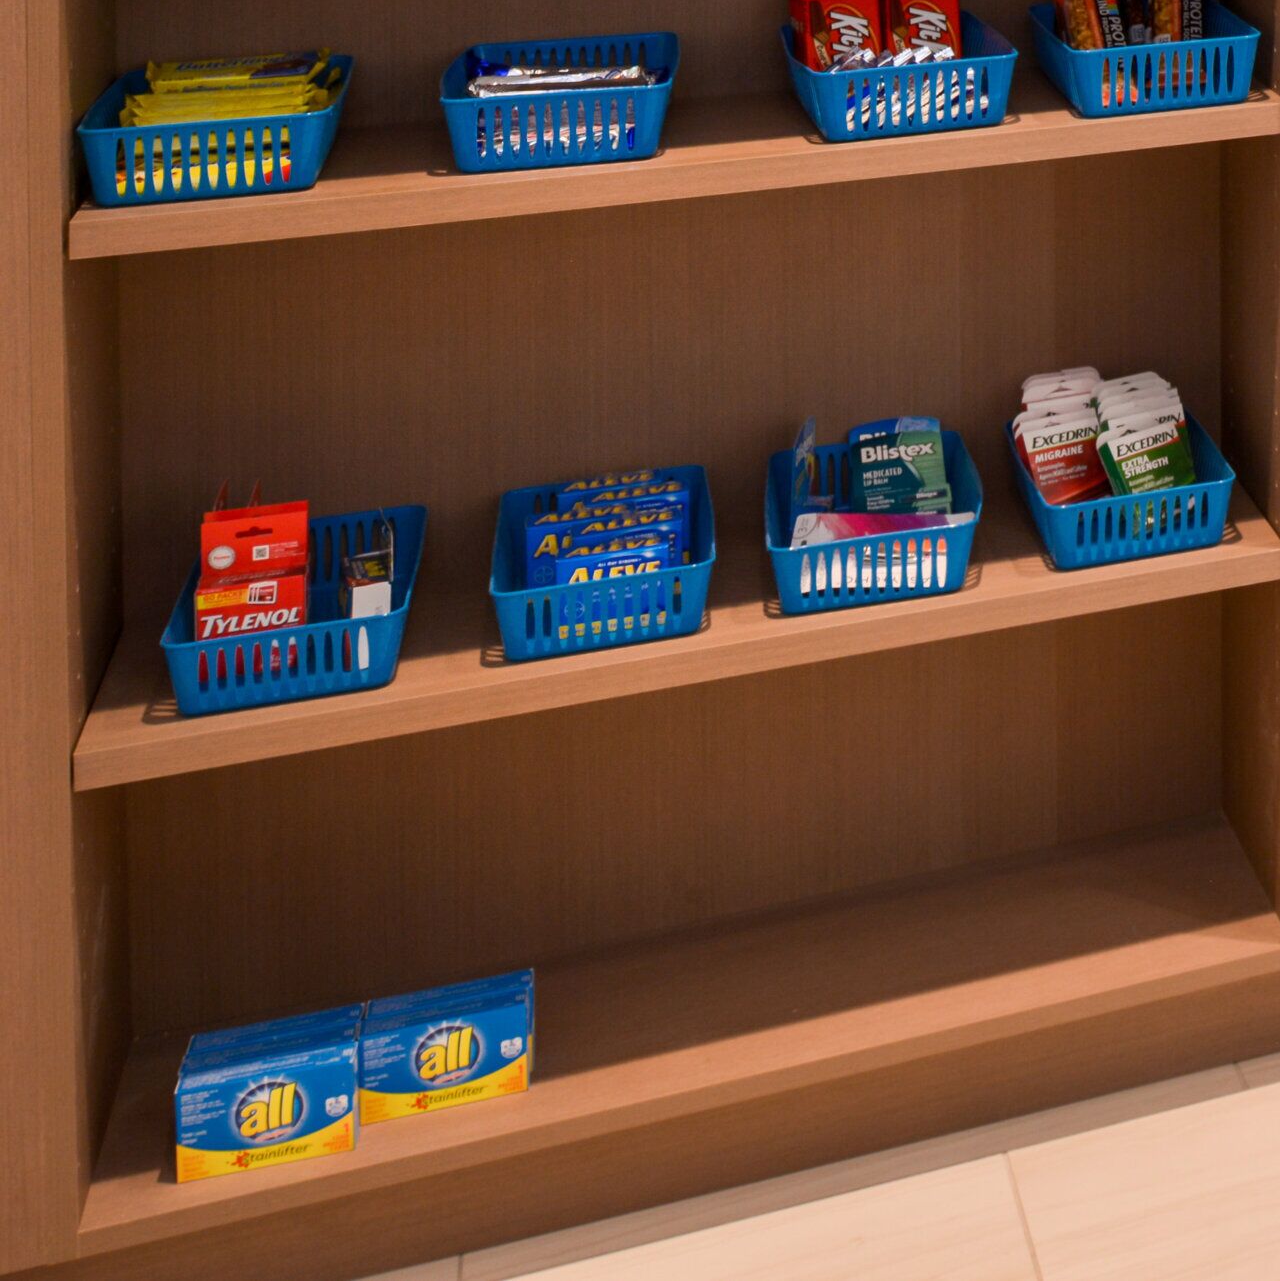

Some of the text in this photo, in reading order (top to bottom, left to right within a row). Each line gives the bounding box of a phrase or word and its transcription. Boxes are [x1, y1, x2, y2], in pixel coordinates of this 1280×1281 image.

[1032, 425, 1098, 450] EXCEDRIN
[1116, 430, 1175, 457] EXCEDRIN
[861, 441, 935, 464] Blistex
[1035, 444, 1084, 464] MIGRAINE
[863, 467, 903, 480] MEDICATED
[1125, 457, 1169, 479] STRENGTH
[200, 606, 303, 638] TYLENOL
[419, 1026, 473, 1081] all
[240, 1082, 297, 1139] all
